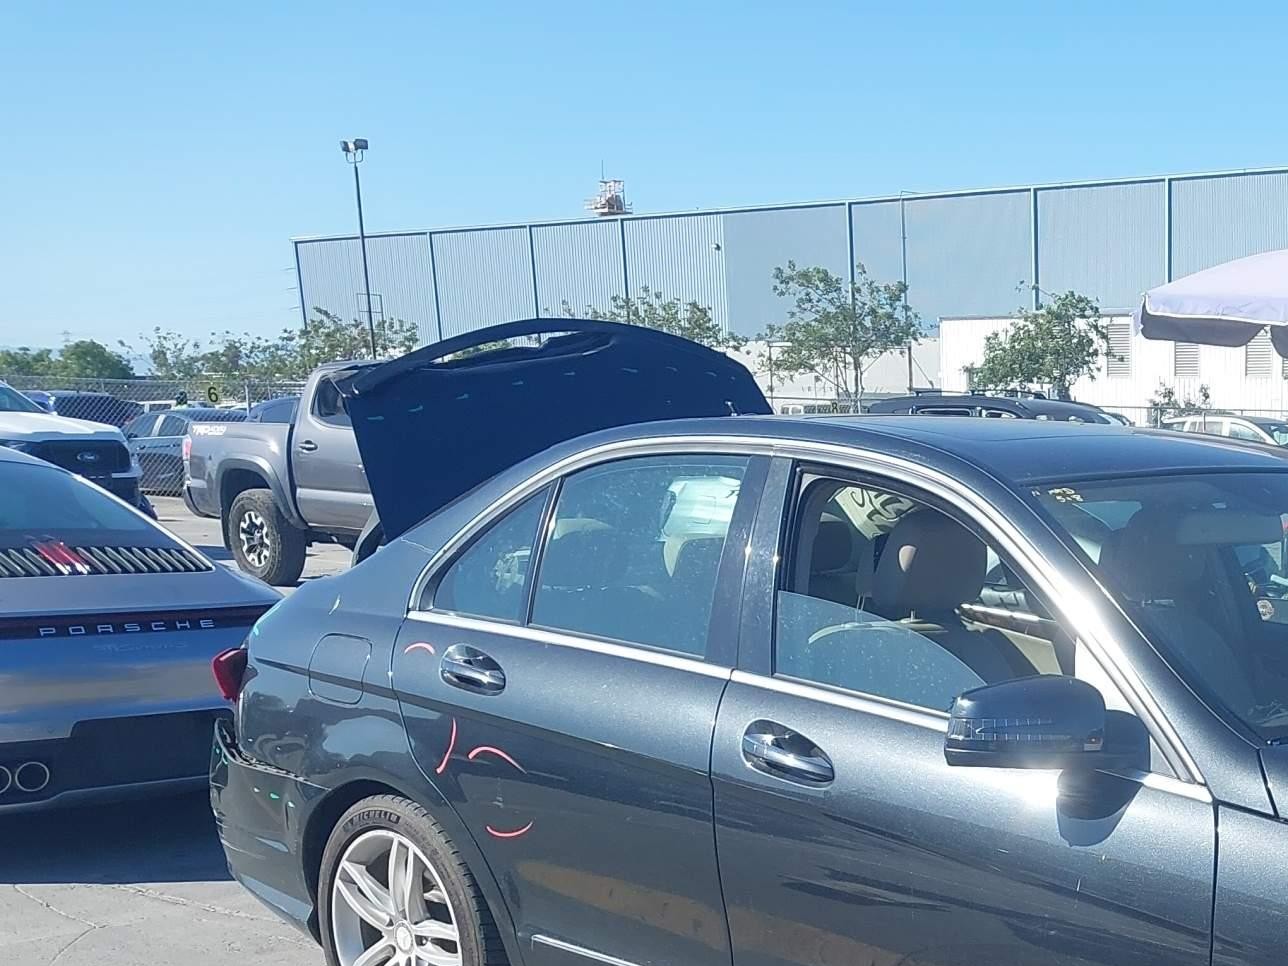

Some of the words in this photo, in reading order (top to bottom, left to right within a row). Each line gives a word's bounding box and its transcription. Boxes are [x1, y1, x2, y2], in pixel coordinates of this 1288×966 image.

[207, 386, 219, 403] 6
[39, 619, 215, 637] PORSCHE
[352, 809, 400, 824] MICHELIN
